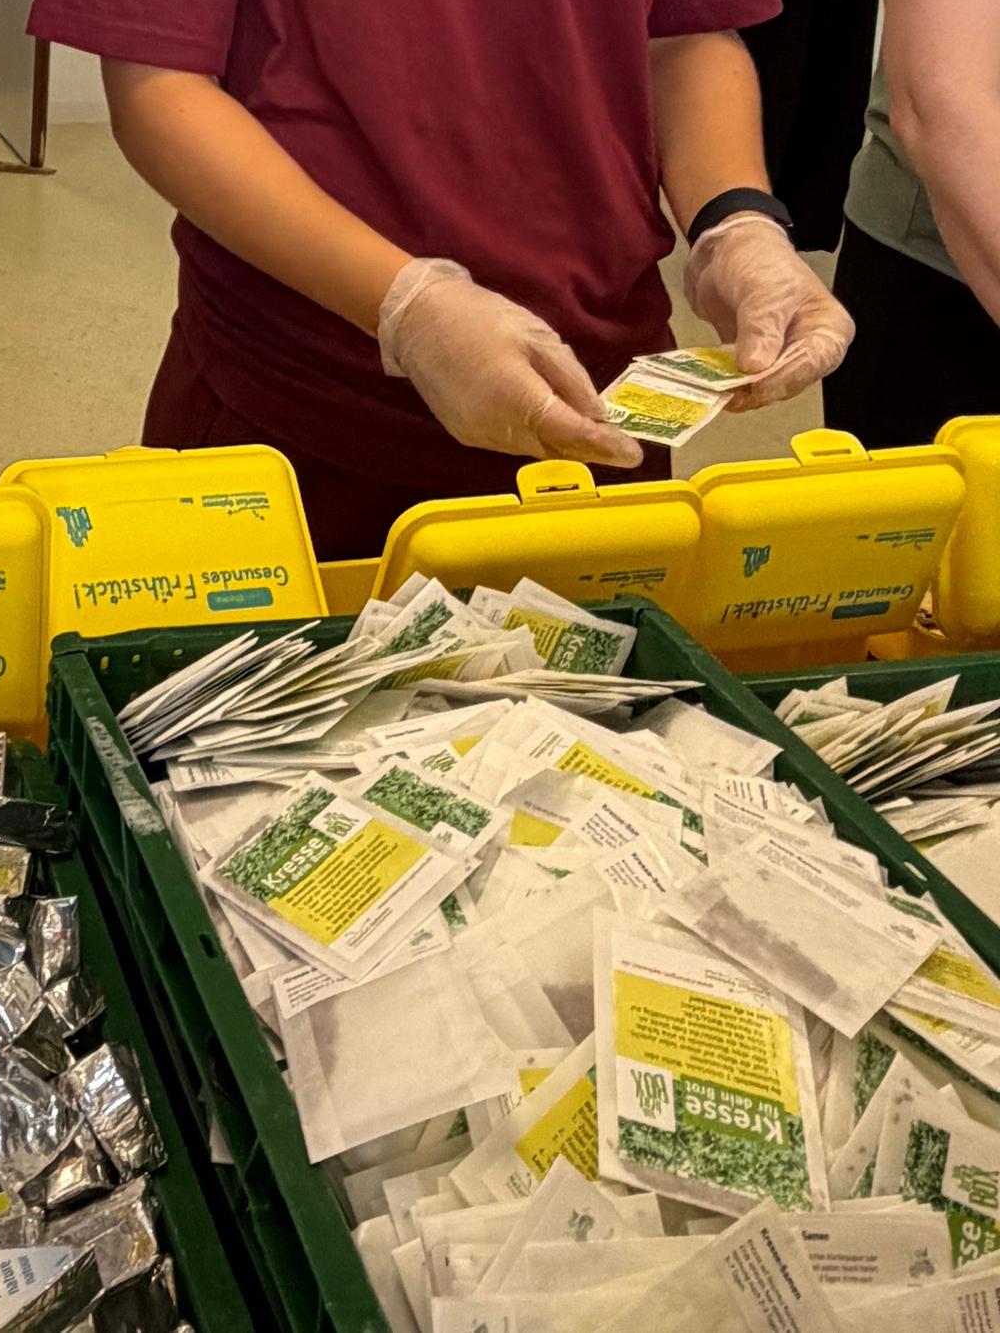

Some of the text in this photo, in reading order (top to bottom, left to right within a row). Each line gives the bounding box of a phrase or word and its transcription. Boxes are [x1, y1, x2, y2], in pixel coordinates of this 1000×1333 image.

[73, 574, 198, 609] Frühstück!
[202, 565, 288, 589] Gesundes
[838, 584, 915, 602] Gesundes
[720, 594, 832, 624] Frühstück!
[560, 633, 586, 669] Kres
[260, 837, 325, 890] Kresse
[685, 1079, 780, 1120] für dein Brot
[684, 1094, 784, 1145] Kresse
[0, 1258, 20, 1296] nature
